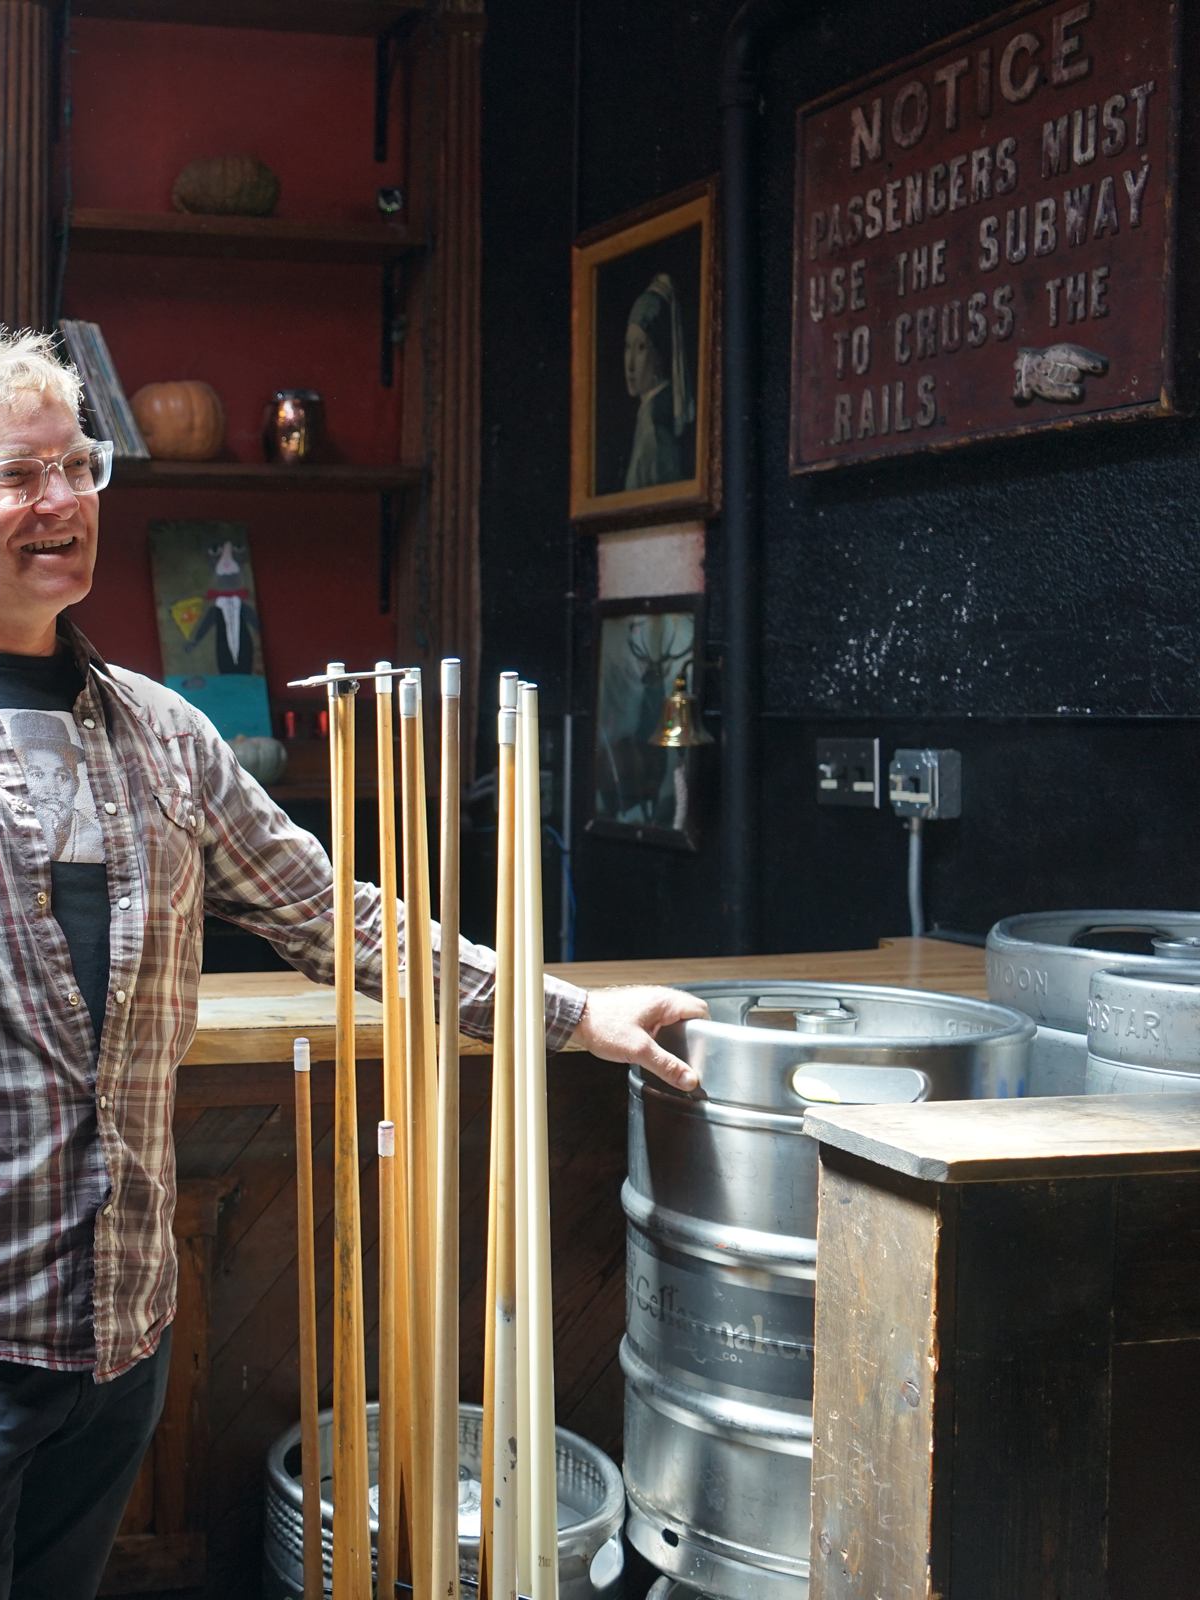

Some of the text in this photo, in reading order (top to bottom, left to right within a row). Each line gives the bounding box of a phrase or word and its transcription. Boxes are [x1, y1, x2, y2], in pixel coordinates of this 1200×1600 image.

[850, 2, 1090, 169] NOTICE
[809, 164, 1150, 322] USE THE SUBWAY
[810, 81, 1156, 260] PASSENGERS MUST
[833, 265, 1110, 379] TO CROSS THE
